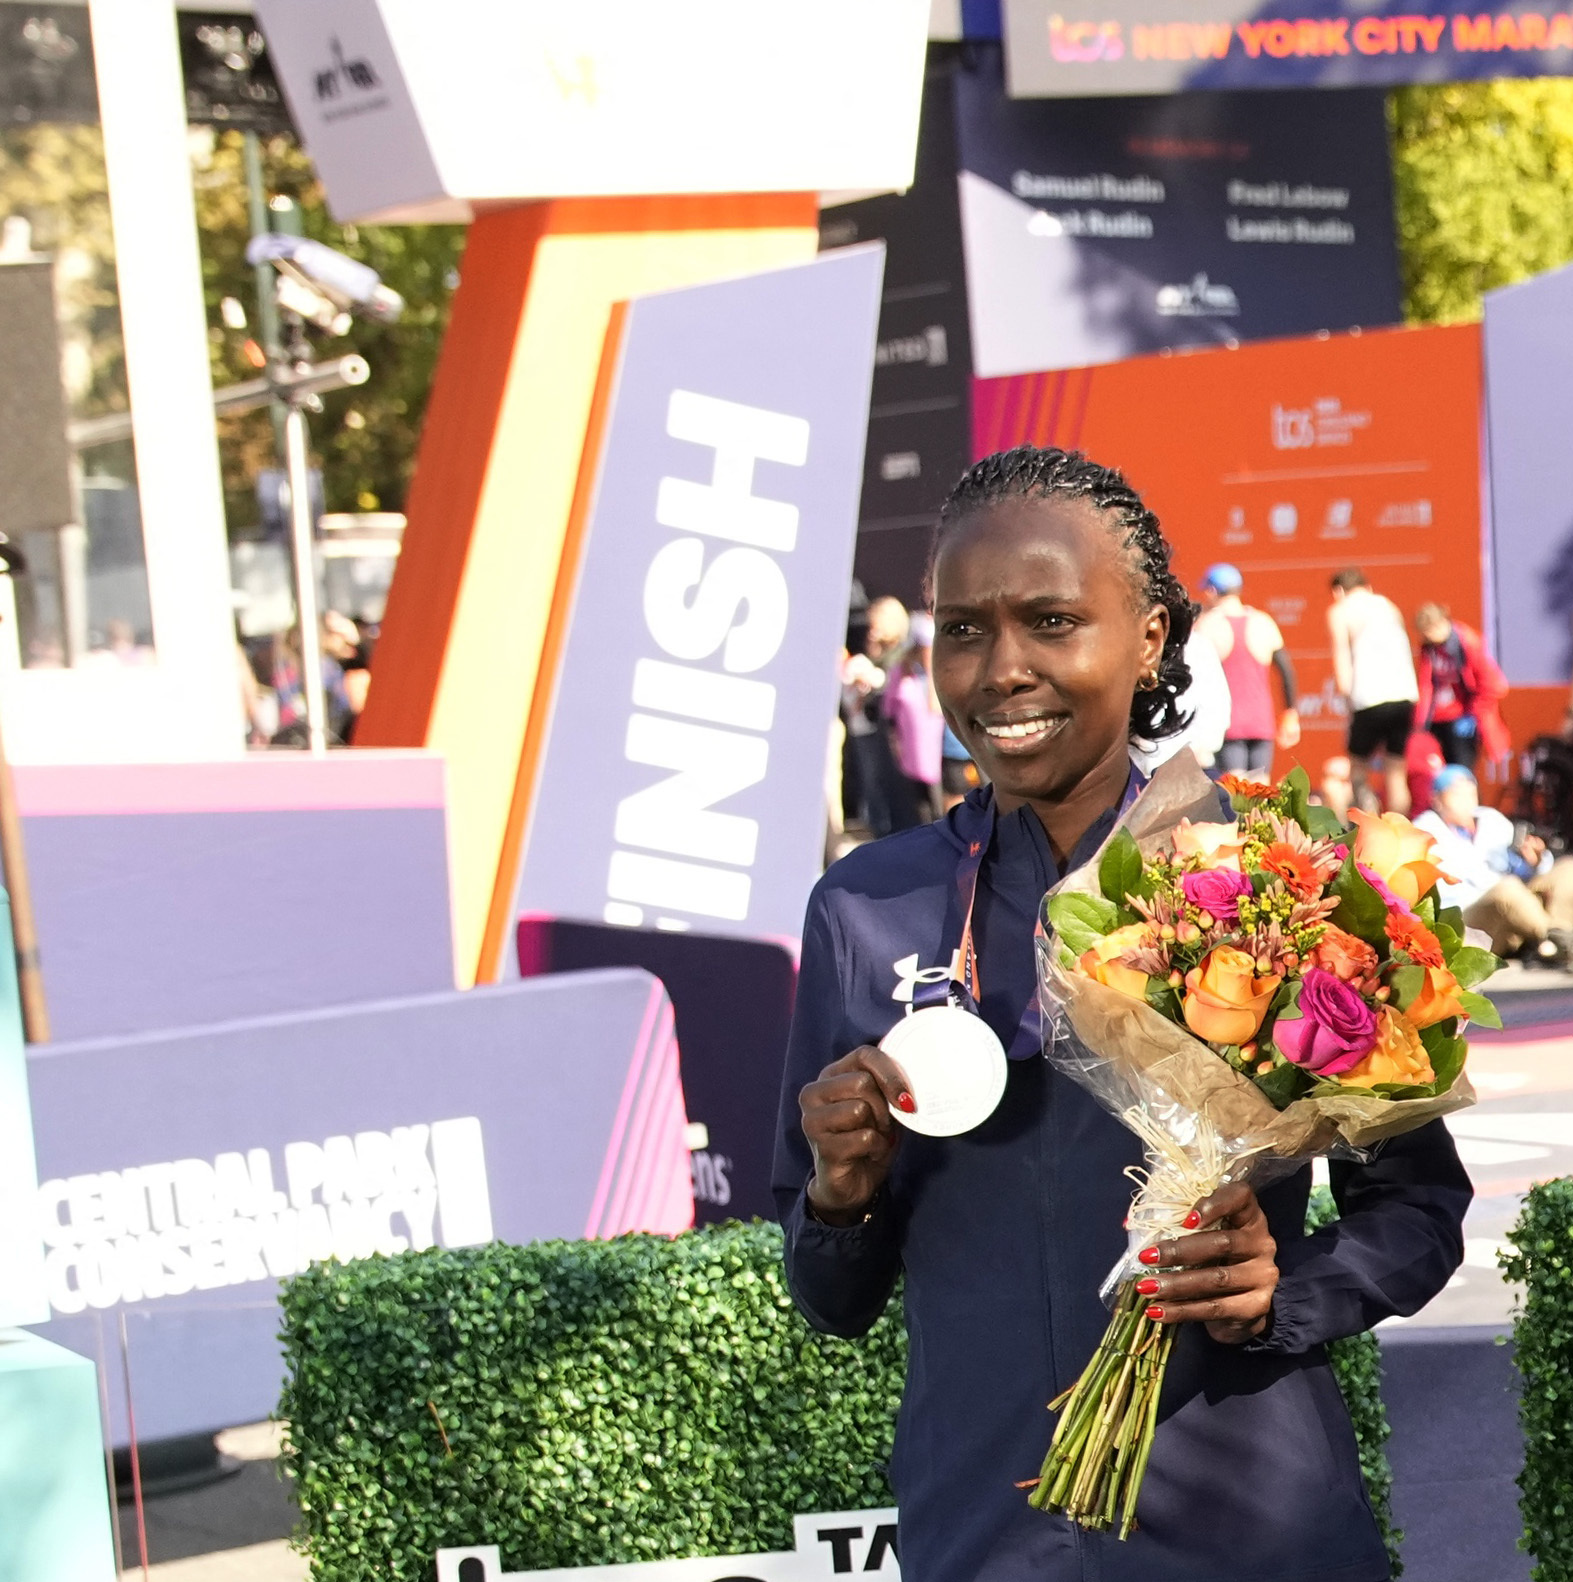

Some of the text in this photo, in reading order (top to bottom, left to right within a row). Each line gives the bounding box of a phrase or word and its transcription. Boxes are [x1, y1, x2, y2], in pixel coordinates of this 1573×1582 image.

[1132, 21, 1231, 60] NEW
[1236, 16, 1350, 60] YORK
[1352, 15, 1446, 56] CITY
[604, 388, 810, 932] INISH
[37, 1123, 438, 1249] CENTRAL PARK
[44, 1200, 438, 1314] CONSERVANCY
[817, 1523, 900, 1574] TA
